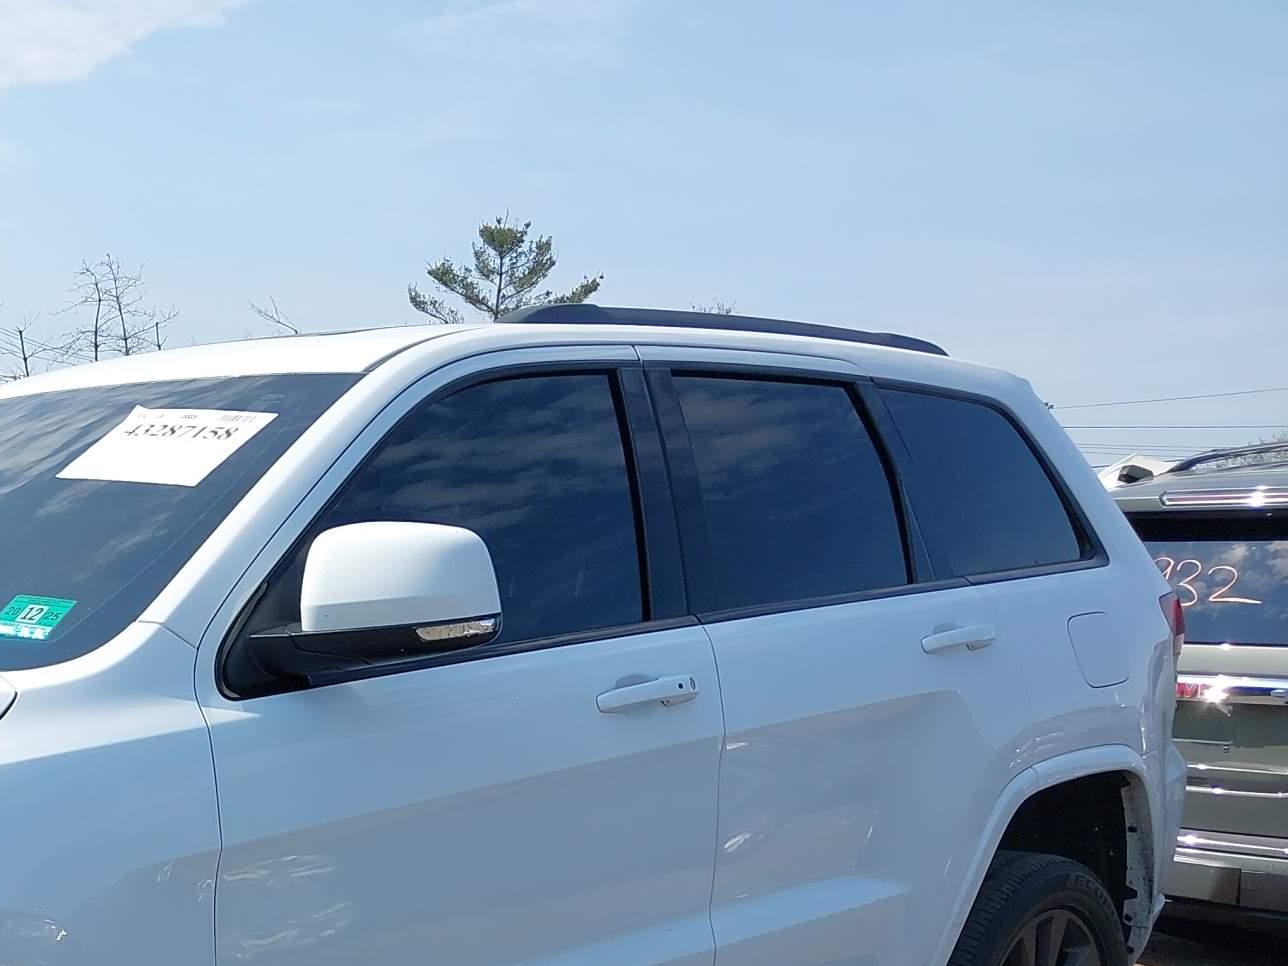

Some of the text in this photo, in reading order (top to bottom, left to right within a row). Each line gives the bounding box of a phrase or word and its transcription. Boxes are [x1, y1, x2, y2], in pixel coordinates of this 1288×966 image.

[124, 423, 240, 441] 43287158
[20, 606, 44, 621] 12
[44, 611, 62, 621] 25
